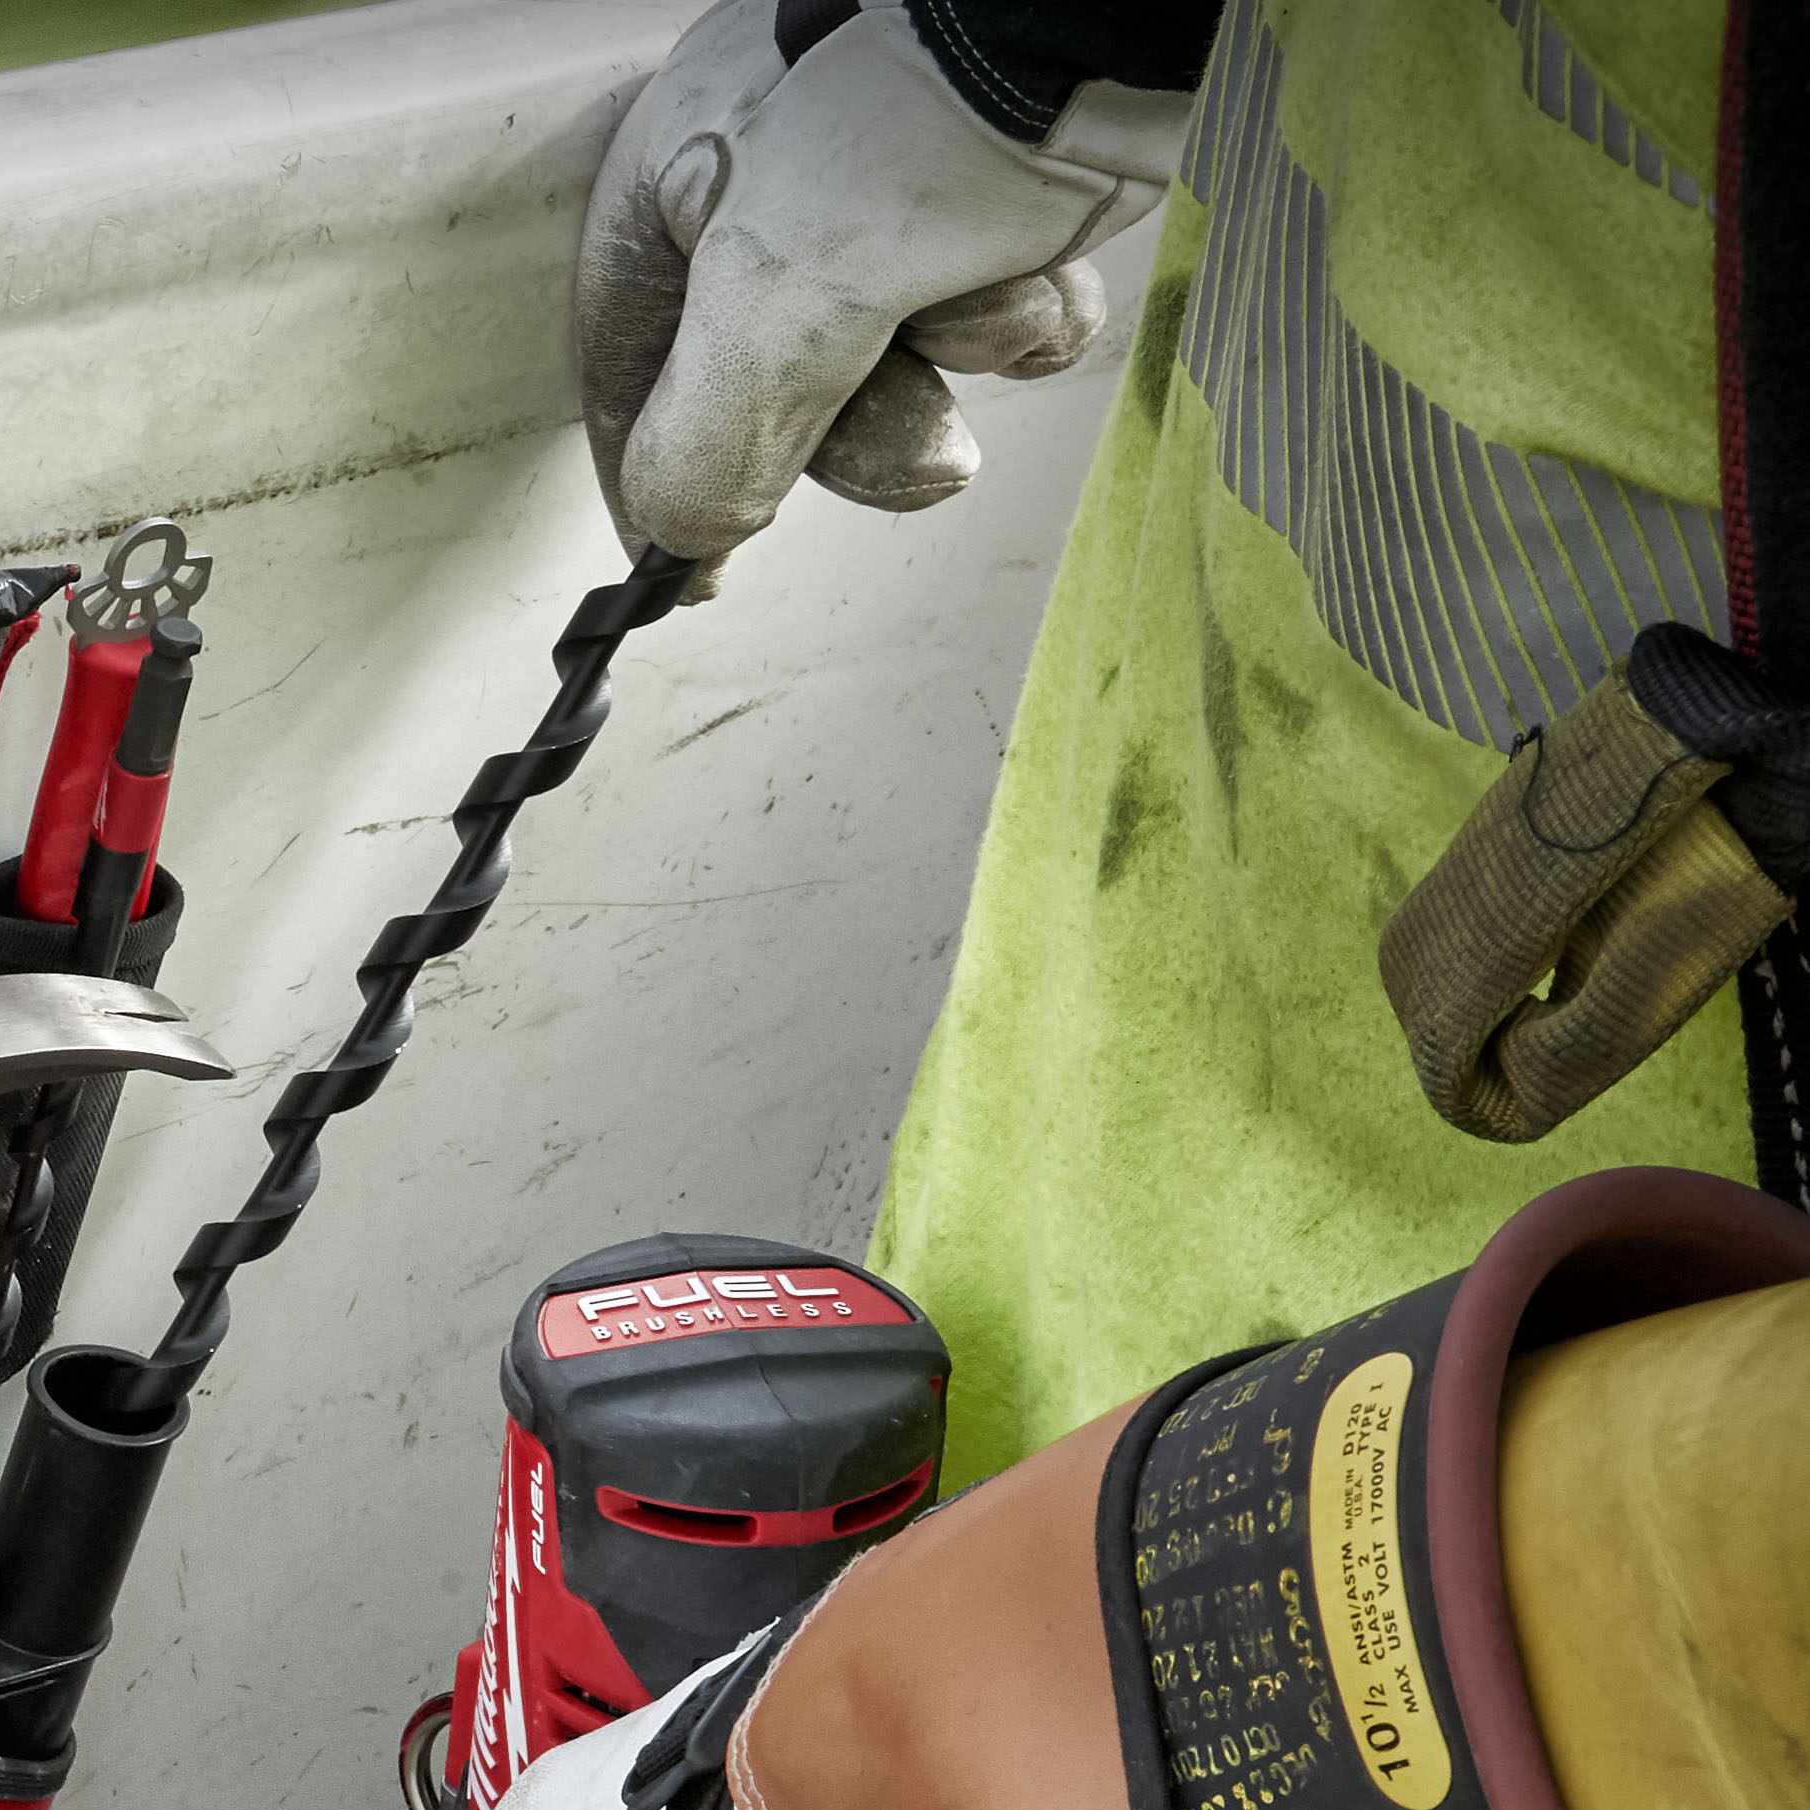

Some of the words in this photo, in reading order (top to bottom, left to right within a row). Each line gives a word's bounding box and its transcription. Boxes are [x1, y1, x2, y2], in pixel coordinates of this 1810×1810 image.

[577, 1274, 839, 1321] FUEL
[590, 1301, 853, 1341] BRUSHLESS
[1343, 1402, 1362, 1457] D120
[1357, 1402, 1376, 1455] TYPE
[1376, 1405, 1393, 1432] AC
[1345, 1482, 1356, 1530] MADE
[1370, 1446, 1386, 1525] 17000V
[530, 1462, 546, 1575] FUEL
[1358, 1553, 1370, 1568] 2
[1371, 1541, 1391, 1597] VOLT
[1341, 1541, 1372, 1666] ANSI/ASTM
[1362, 1590, 1386, 1660] CLASS
[1382, 1609, 1402, 1651] USE
[1393, 1665, 1420, 1713] MAX
